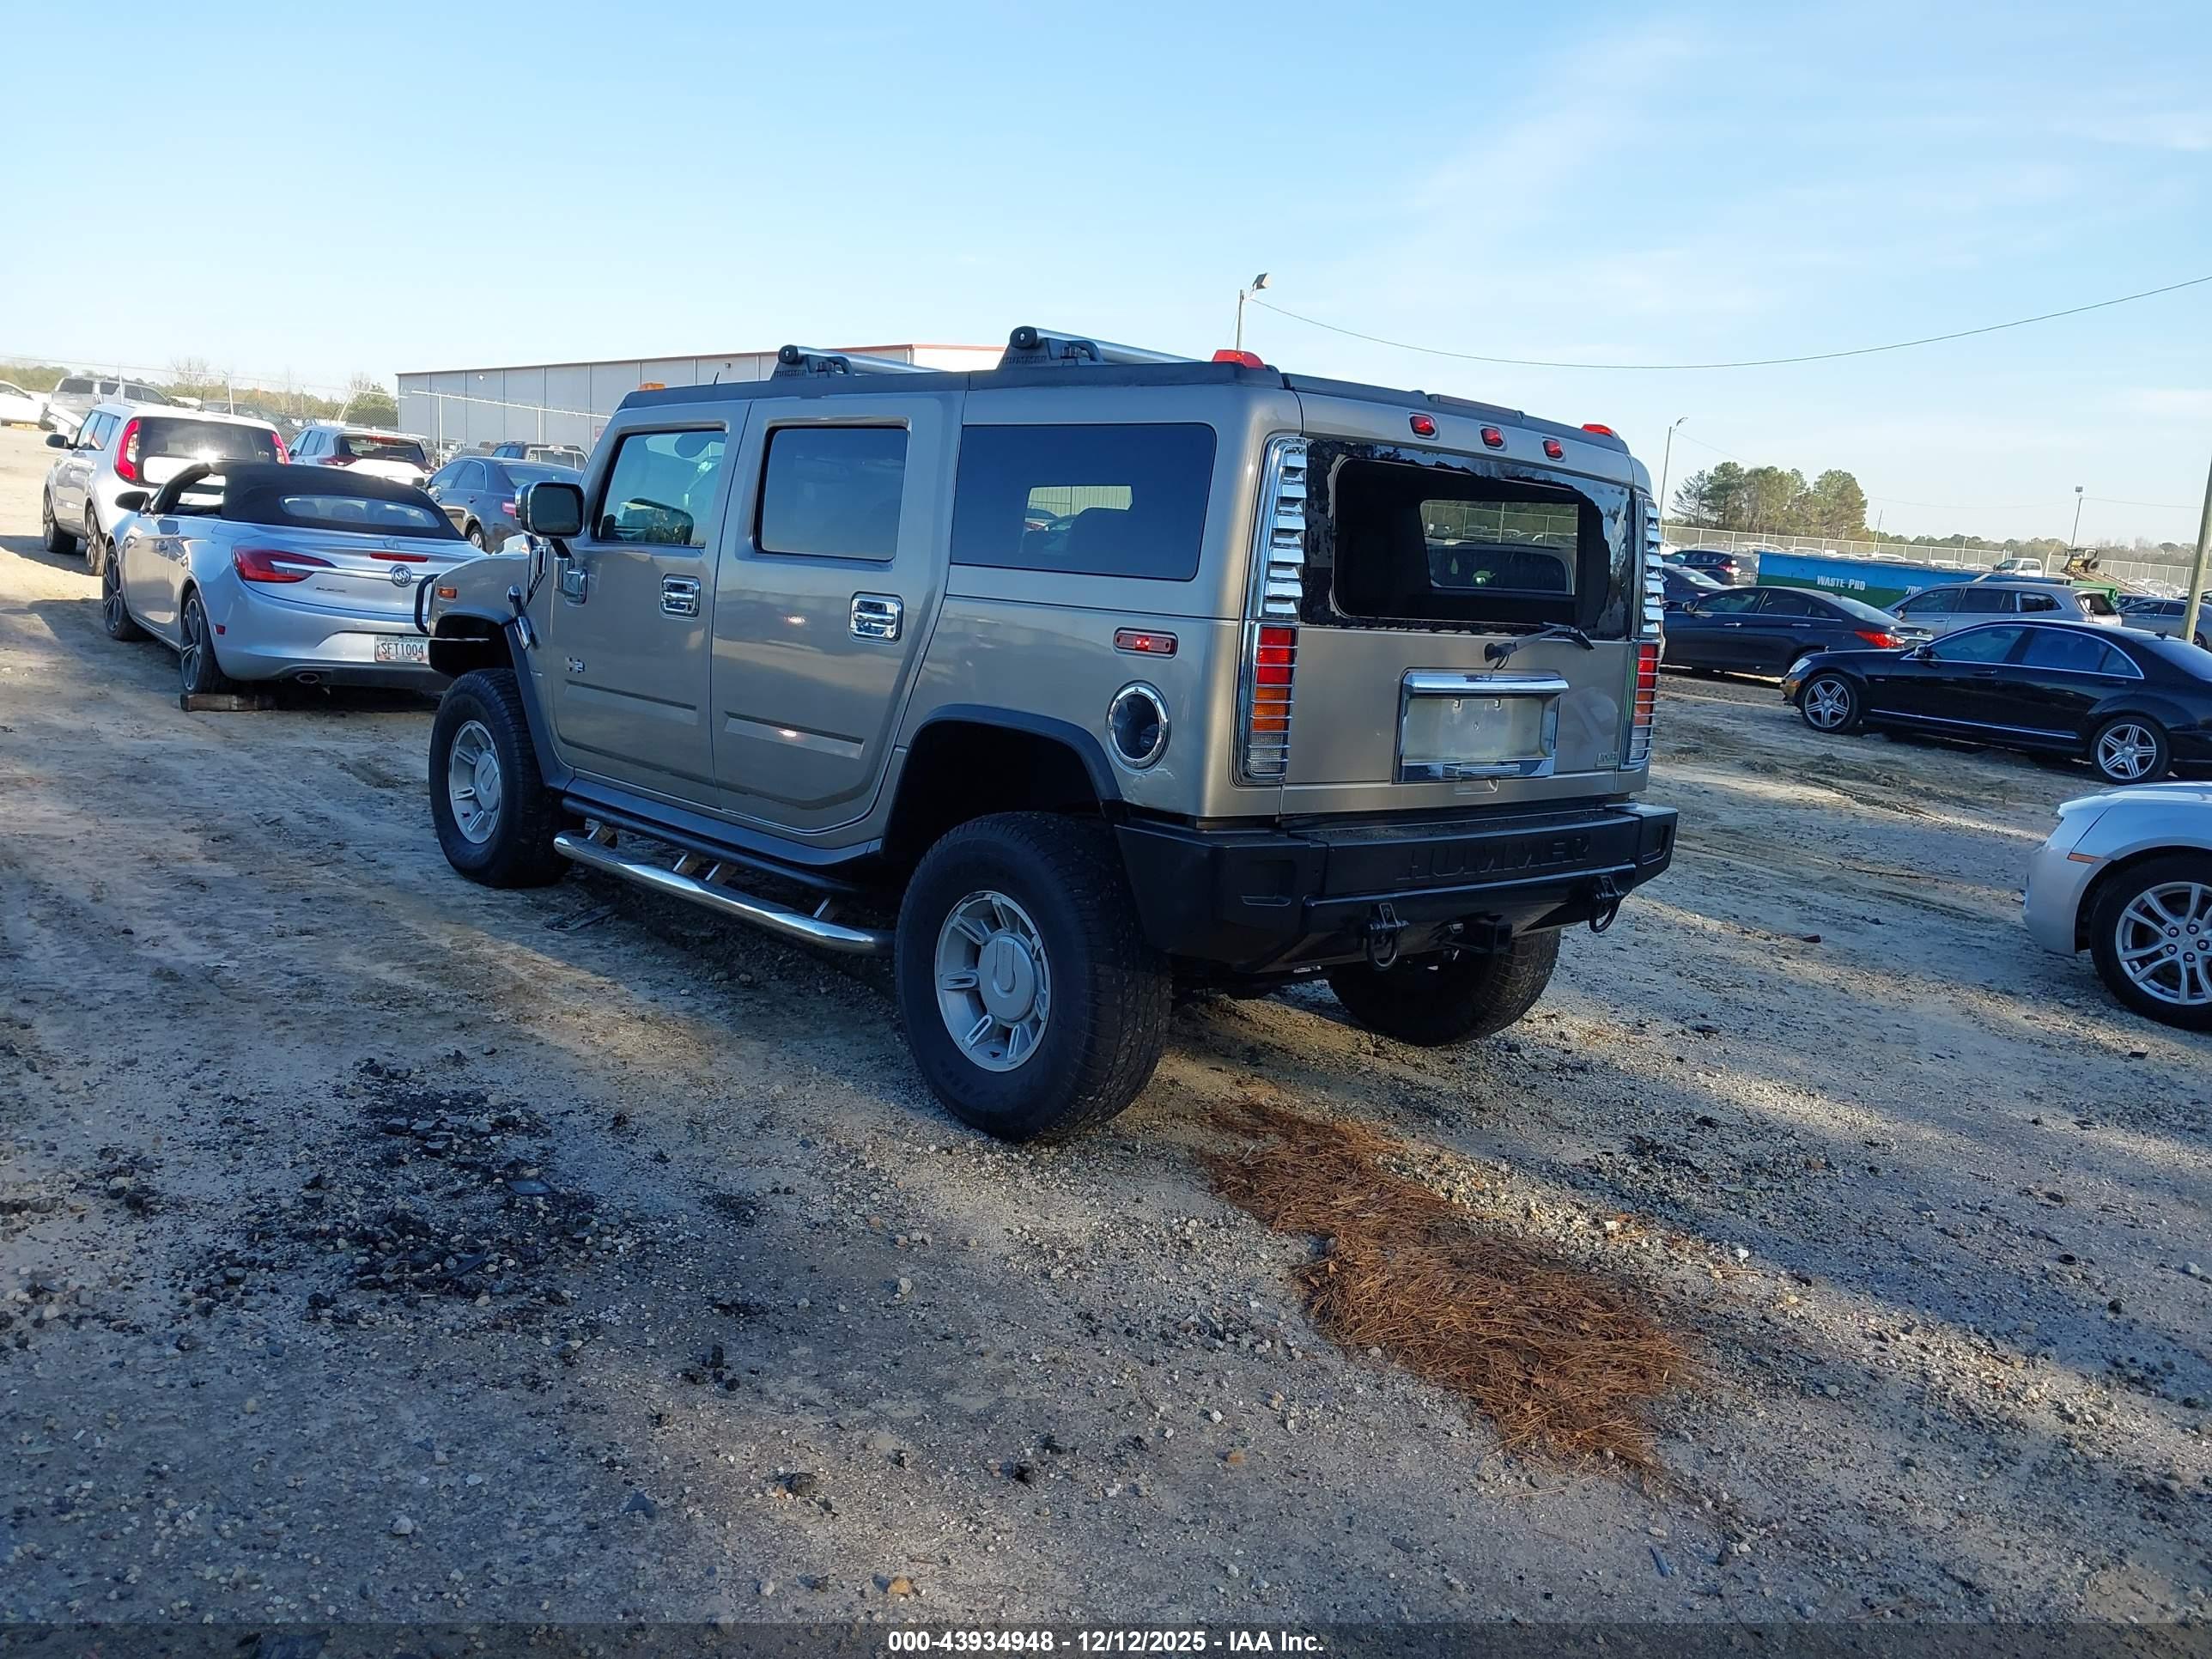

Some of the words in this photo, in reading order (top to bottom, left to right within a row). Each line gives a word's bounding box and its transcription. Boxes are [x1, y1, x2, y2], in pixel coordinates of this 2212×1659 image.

[1817, 575, 1845, 588] WASTE
[1848, 579, 1866, 591] PRO
[380, 642, 424, 658] SFT1004
[1395, 836, 1590, 881] HUMMER
